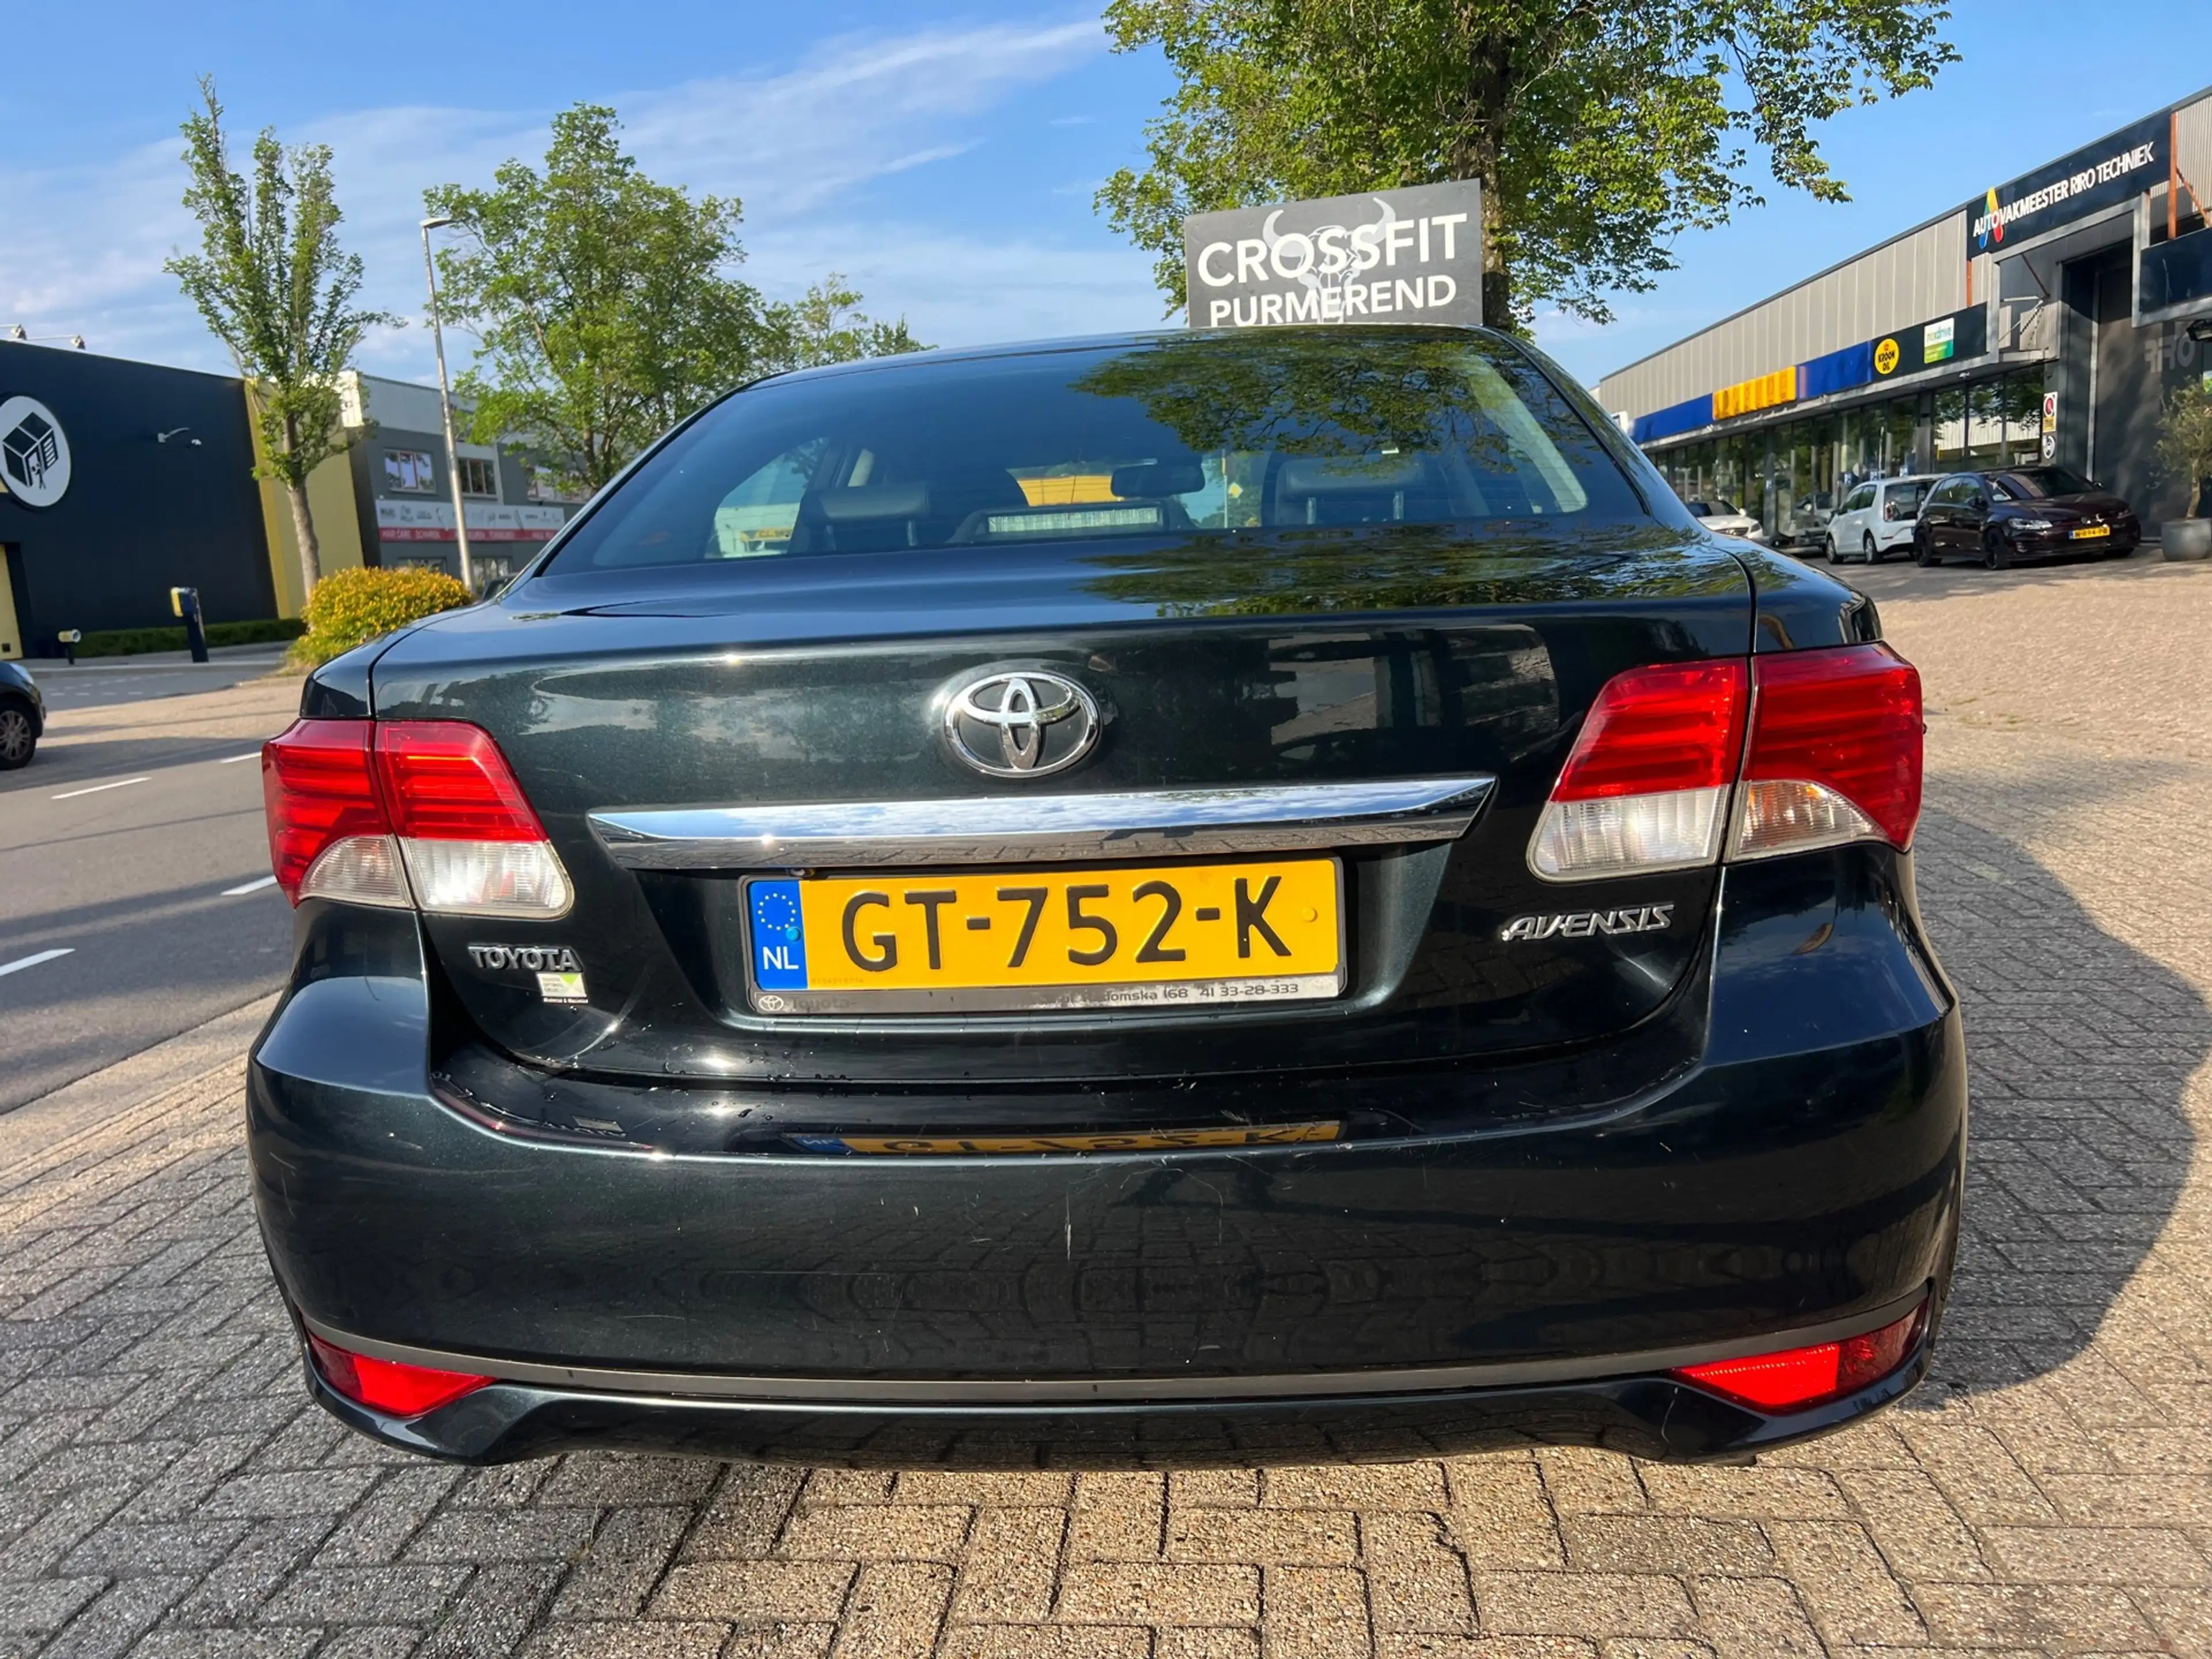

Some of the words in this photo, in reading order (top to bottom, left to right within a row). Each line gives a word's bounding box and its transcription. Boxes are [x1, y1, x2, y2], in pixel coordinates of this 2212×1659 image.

[1972, 179, 2069, 237] AUTOVAKMEESTER
[2070, 168, 2097, 196] RIRO
[2096, 142, 2154, 184] TECHNIEK
[1198, 213, 1468, 287] CROSSFIT
[1210, 275, 1456, 327] PURMEREND
[842, 876, 1292, 972] GT-752-K
[1501, 904, 1675, 942] AVENSIS
[468, 945, 581, 972] TOYOTA
[762, 945, 800, 970] NL
[1220, 984, 1298, 997] 33-28-333
